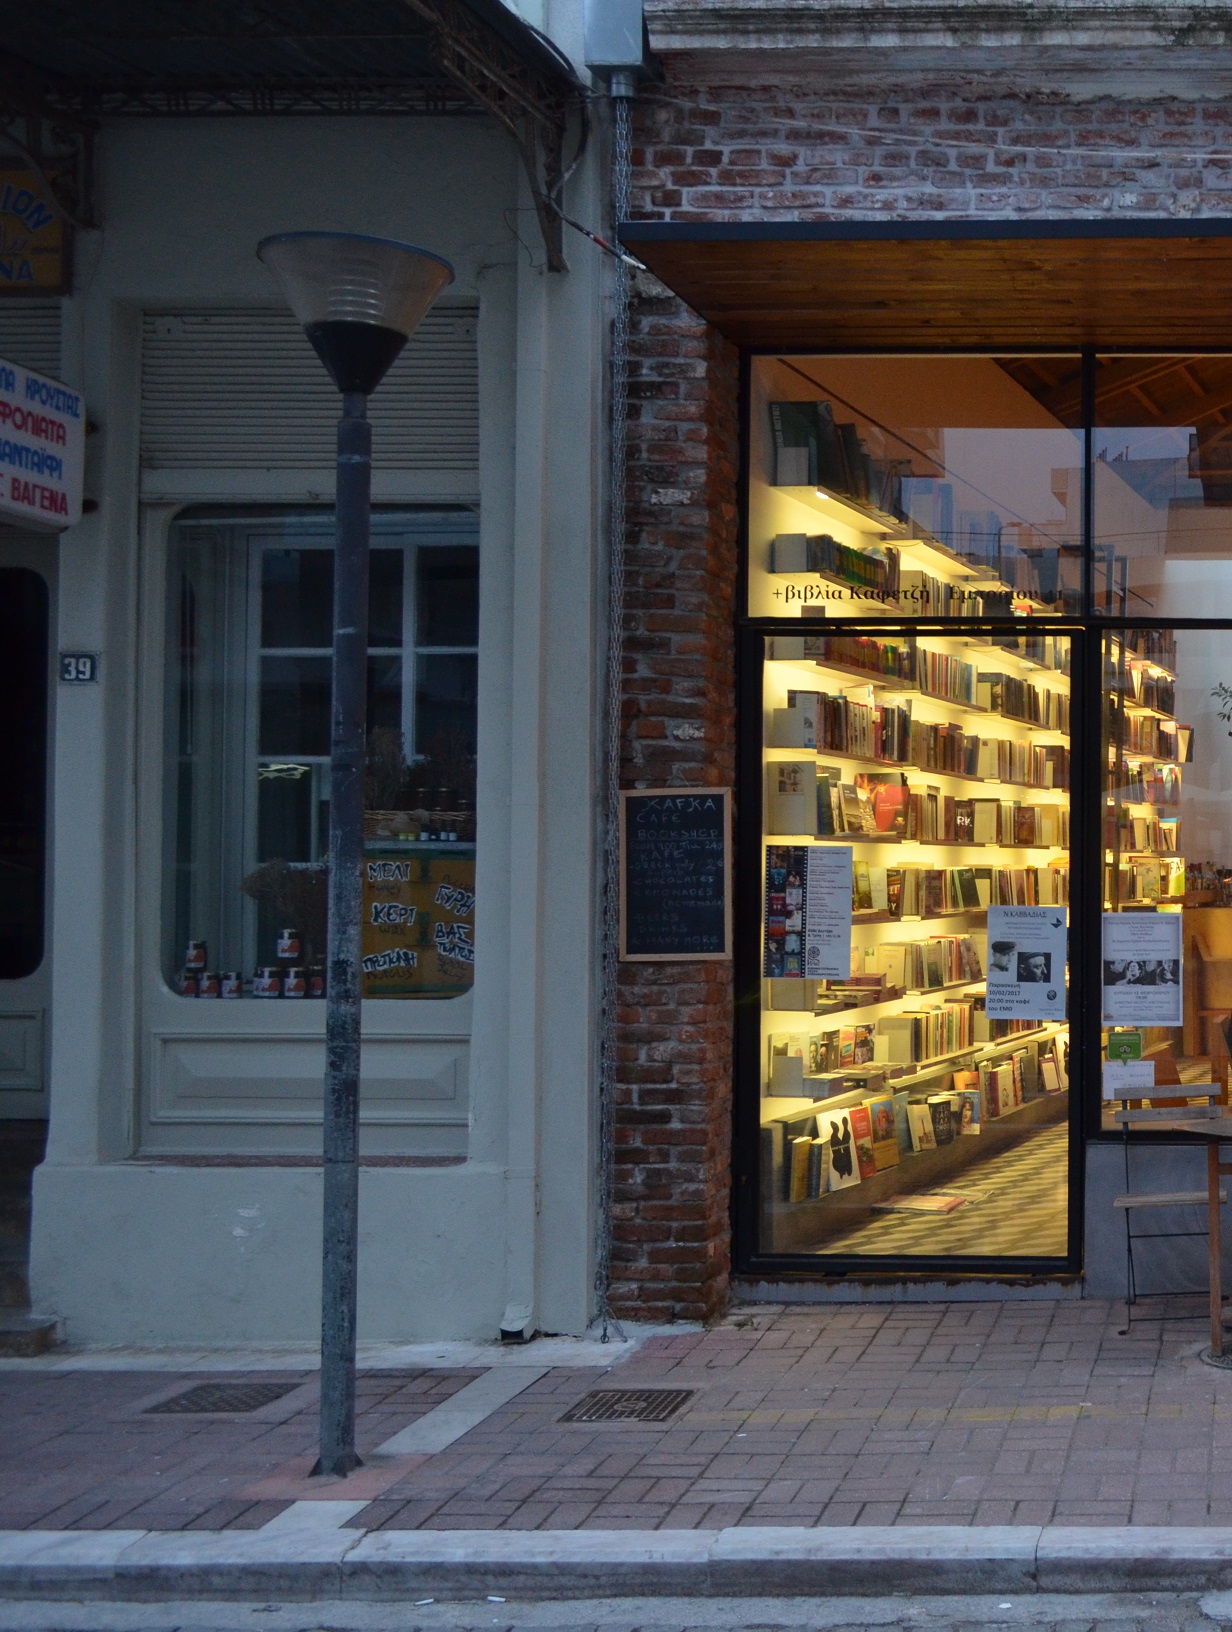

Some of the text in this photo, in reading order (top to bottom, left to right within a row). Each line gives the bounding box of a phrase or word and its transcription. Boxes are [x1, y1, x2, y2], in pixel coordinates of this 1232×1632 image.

[26, 377, 80, 419] ΚΡΟΥΣΤΑΣ
[11, 477, 68, 516] ΒΑΓΕΝΑ
[850, 585, 930, 603] Καφετζή
[64, 657, 92, 680] 39
[641, 798, 716, 812] KAFKA
[637, 813, 682, 823] CAFE
[638, 829, 719, 840] BOOKSHOP
[367, 862, 411, 881] ΜΕΛΙ
[372, 904, 416, 925] ΚΕΡΙ
